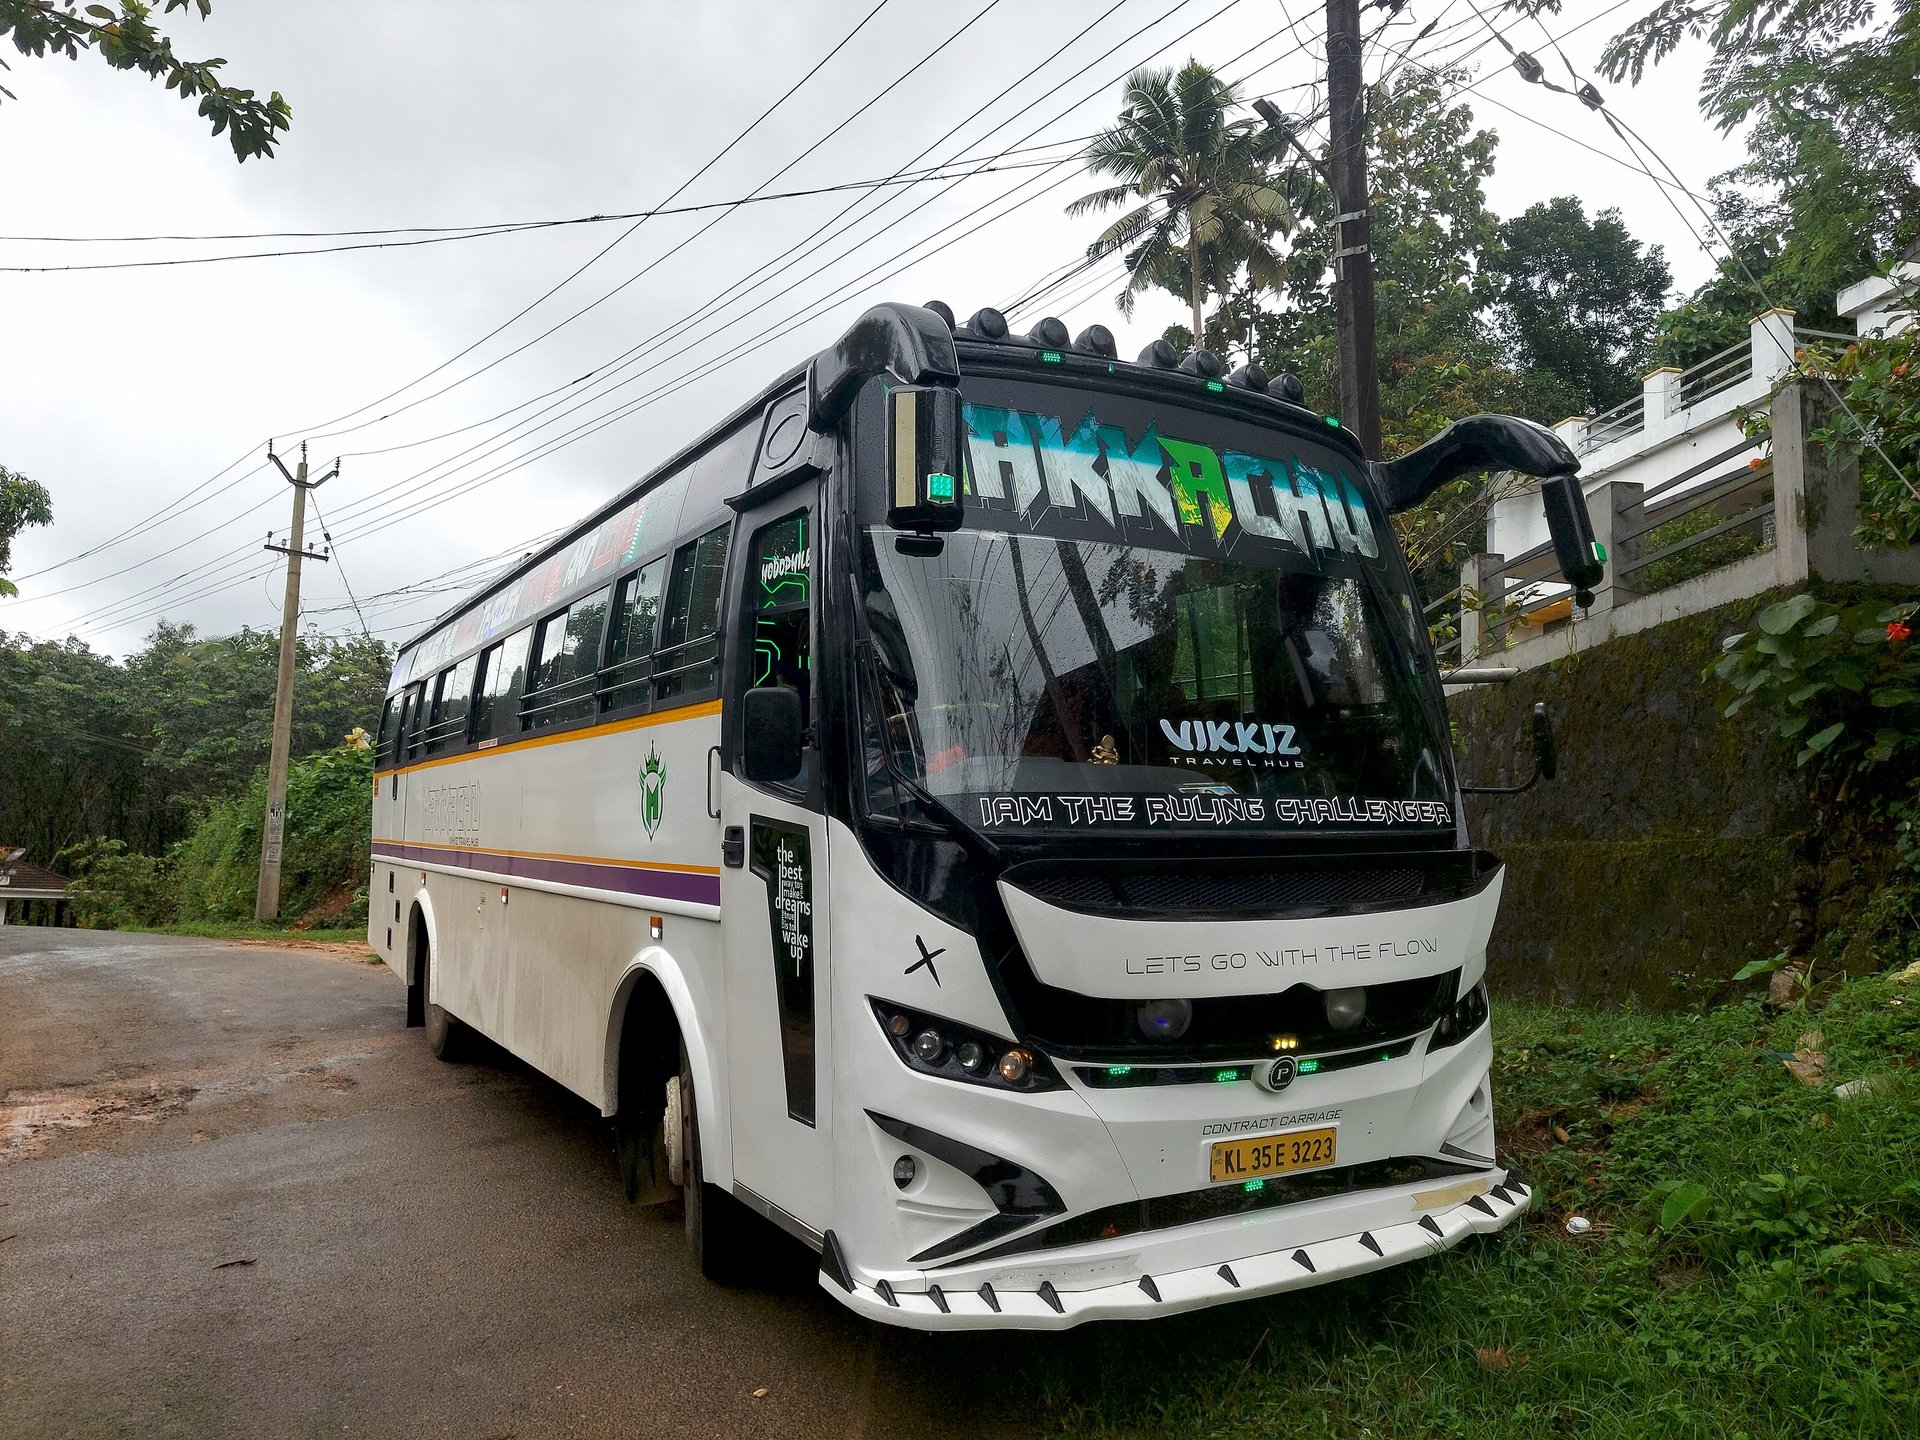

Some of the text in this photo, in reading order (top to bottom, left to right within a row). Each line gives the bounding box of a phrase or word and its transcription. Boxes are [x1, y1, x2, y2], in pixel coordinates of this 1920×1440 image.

[961, 403, 1381, 560] AKKACHU
[562, 532, 600, 587] AND
[1159, 718, 1301, 755] VIKKIZ
[1169, 757, 1305, 768] TRAVEL HUB
[1057, 796, 1136, 824] THE
[1144, 794, 1264, 825] RULING
[1275, 796, 1452, 825] CHALLENGER
[777, 842, 794, 863] the
[782, 863, 803, 881] best
[783, 888, 800, 899] make
[782, 930, 809, 948] wake
[1125, 937, 1438, 975] LETS GO WITH THE FLOW
[1202, 1109, 1343, 1136] CONTRACT CARRIAGE
[1224, 1136, 1333, 1174] KL 35 E 3223
